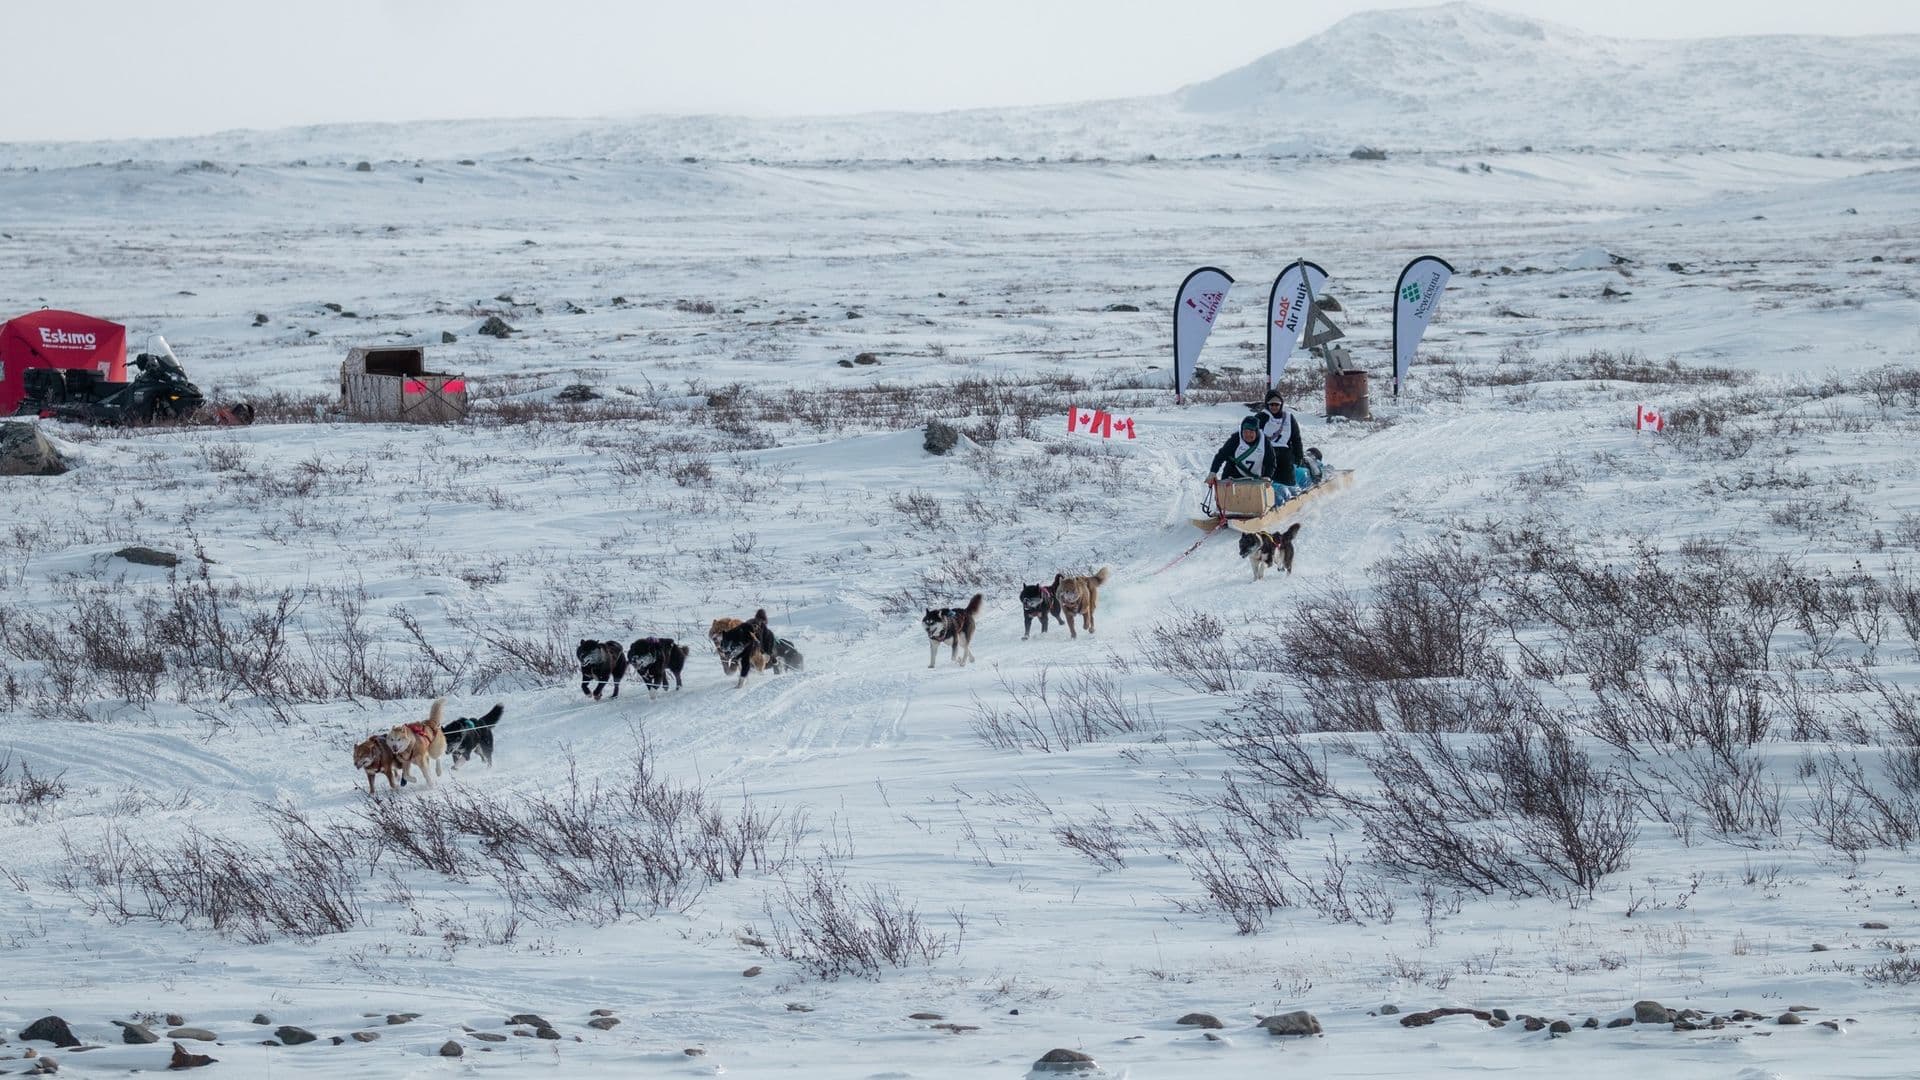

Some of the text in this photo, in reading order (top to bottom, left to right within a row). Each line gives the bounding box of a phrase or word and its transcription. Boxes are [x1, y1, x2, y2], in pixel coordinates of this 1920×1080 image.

[1205, 291, 1223, 323] KATIVIK
[1286, 282, 1307, 332] Air Inuit
[1414, 271, 1441, 318] Newfound
[38, 327, 96, 344] Eskimo
[1245, 460, 1255, 473] 7
